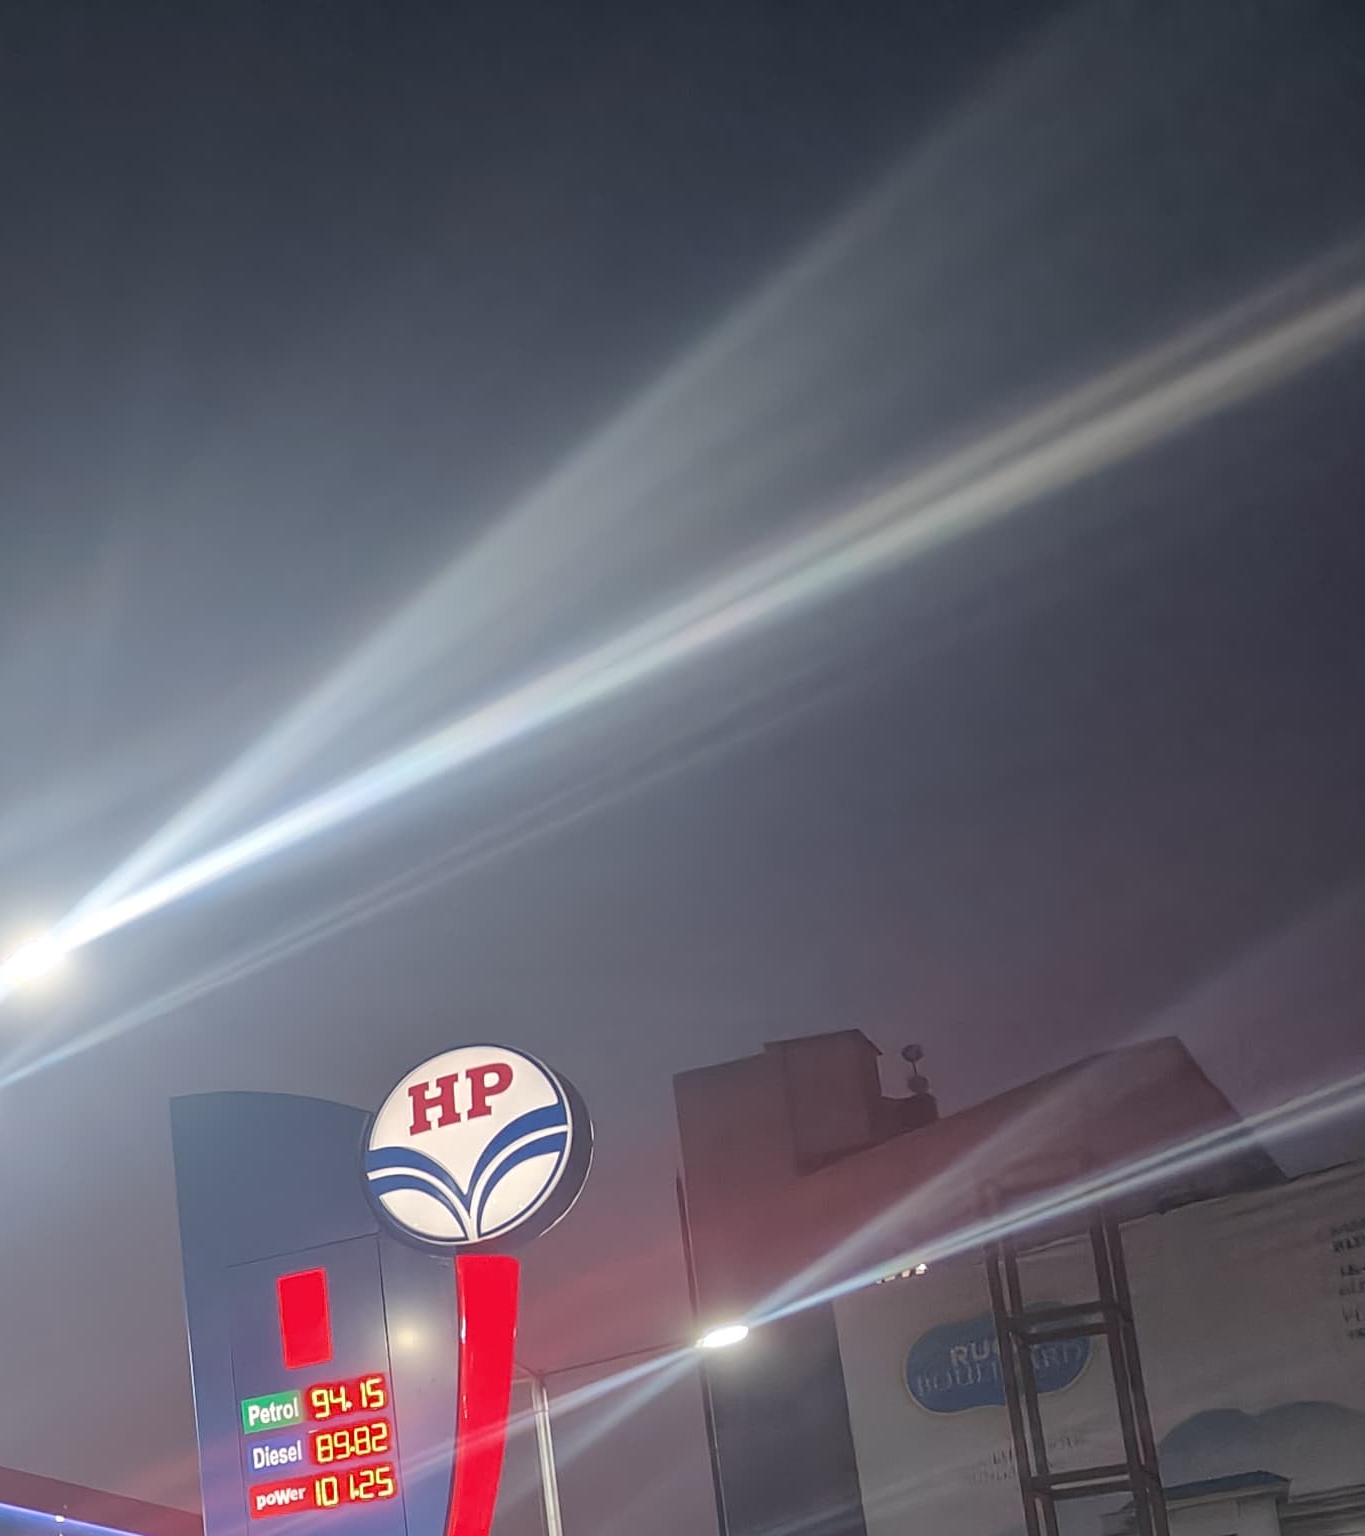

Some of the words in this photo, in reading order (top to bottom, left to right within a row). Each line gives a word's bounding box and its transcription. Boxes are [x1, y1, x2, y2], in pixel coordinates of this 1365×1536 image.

[408, 1062, 514, 1136] HP
[247, 1396, 300, 1427] Petrol
[310, 1377, 385, 1419] 94.15
[252, 1439, 303, 1470] Diesel
[315, 1421, 389, 1464] 89.82
